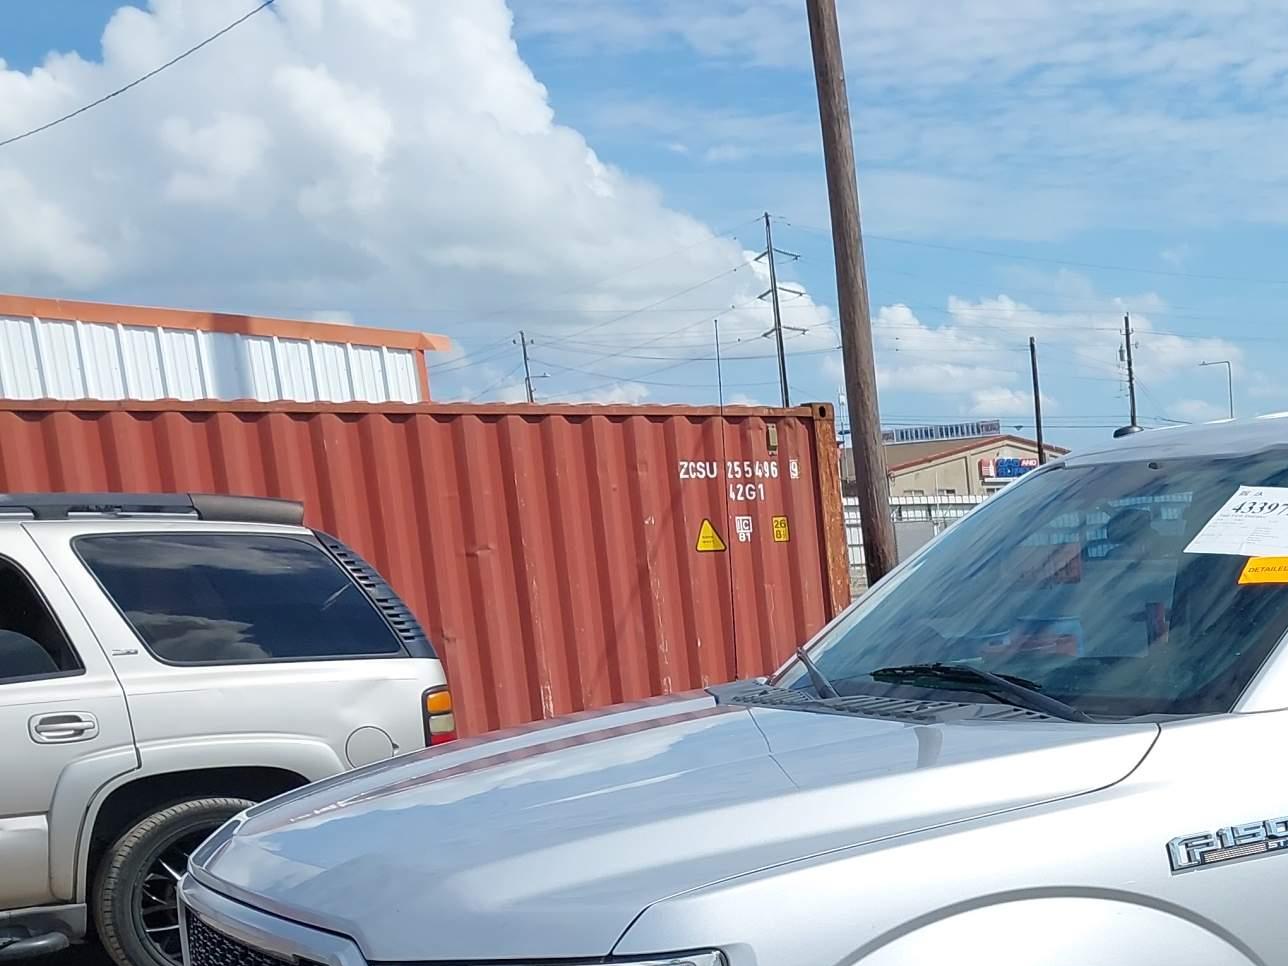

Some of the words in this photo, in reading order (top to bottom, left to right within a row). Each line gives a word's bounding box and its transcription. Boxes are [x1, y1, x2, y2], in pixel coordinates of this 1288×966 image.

[679, 461, 717, 479] ZCSU
[727, 461, 778, 479] 255496
[729, 483, 764, 501] 42G1
